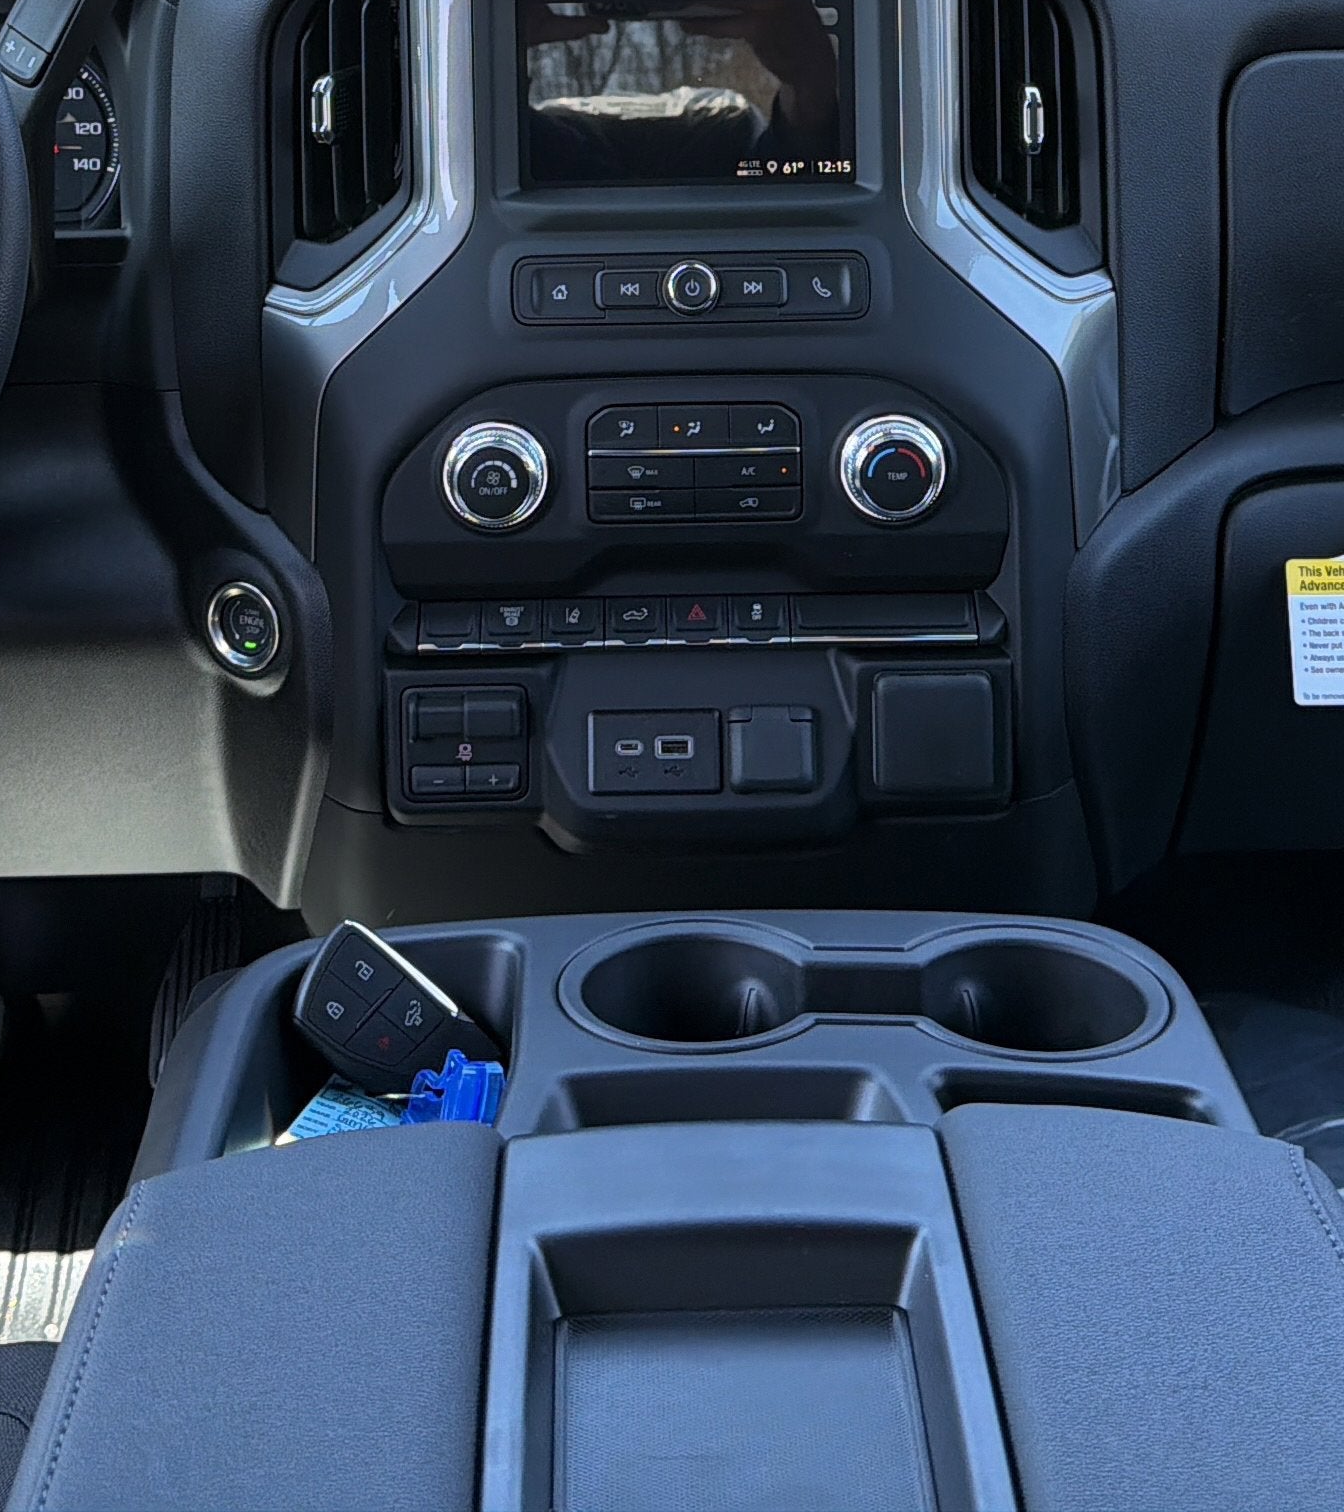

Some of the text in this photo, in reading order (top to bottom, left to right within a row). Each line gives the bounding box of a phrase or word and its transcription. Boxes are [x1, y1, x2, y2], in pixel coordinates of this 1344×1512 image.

[74, 122, 102, 135] 120
[73, 158, 101, 171] 140
[817, 160, 852, 173] 12:15
[741, 466, 756, 476] A/C
[887, 471, 909, 481] TEMP
[479, 486, 508, 496] ON/OFF
[1298, 565, 1323, 577] This
[1300, 602, 1319, 611] Even
[1320, 602, 1337, 610] with
